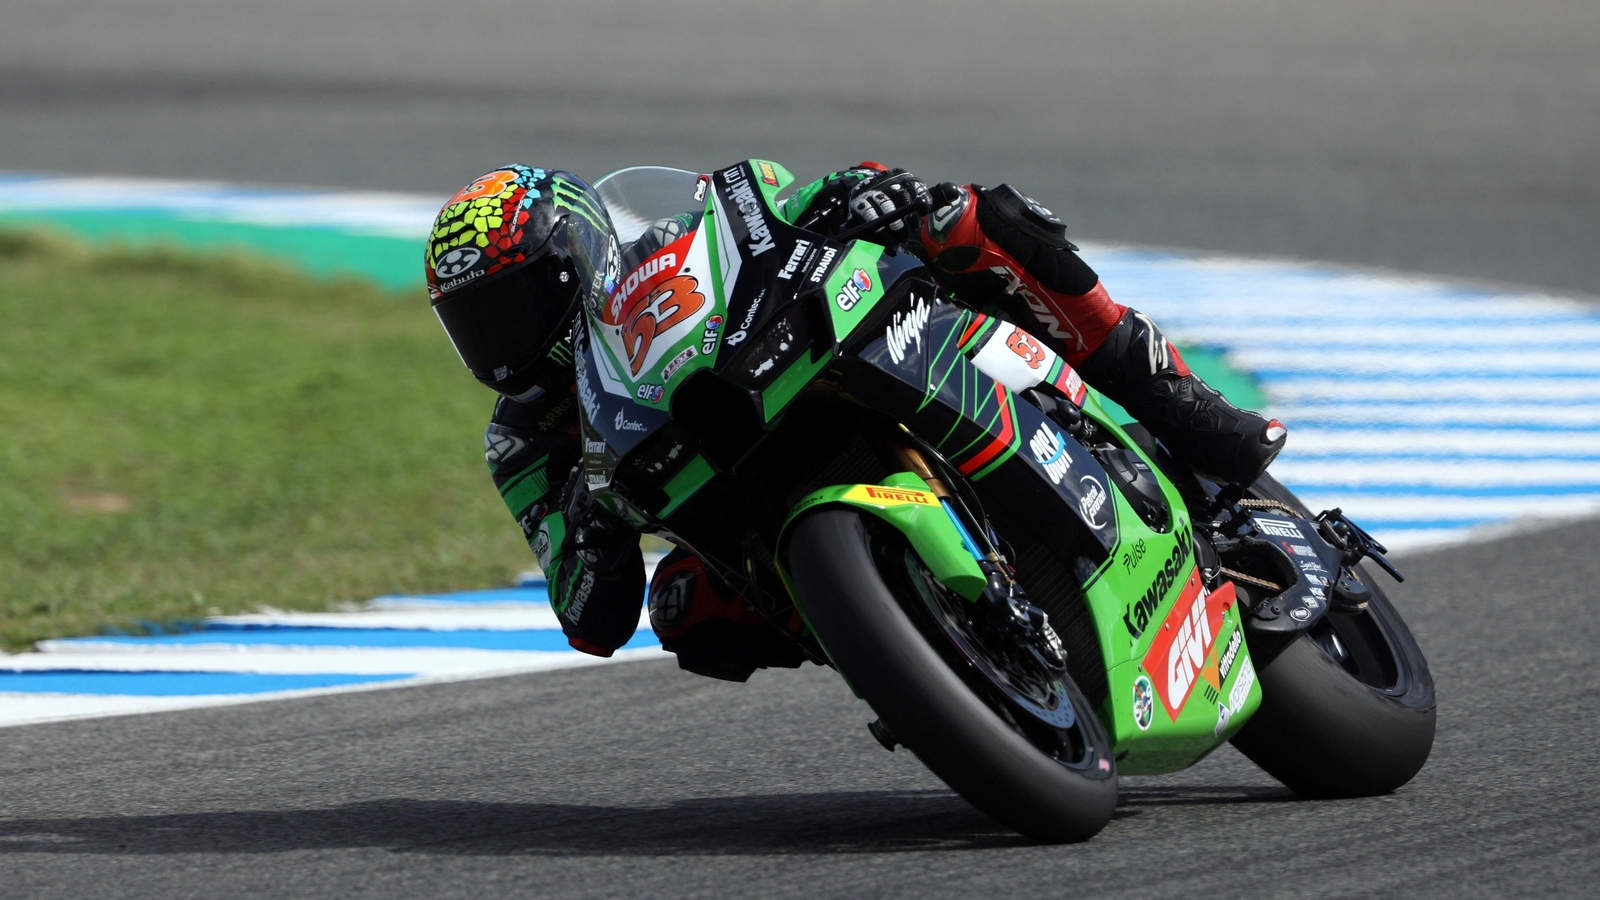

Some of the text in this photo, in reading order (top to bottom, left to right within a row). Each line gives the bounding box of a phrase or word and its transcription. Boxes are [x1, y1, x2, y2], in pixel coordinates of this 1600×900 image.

[777, 239, 811, 280] Ferrari
[440, 269, 485, 293] Kabuto
[611, 252, 677, 325] SHOWA
[621, 275, 705, 377] 53
[740, 296, 761, 330] Contec
[886, 292, 931, 365] Ninja
[1004, 326, 1046, 370] 53
[585, 437, 606, 453] Ferrari
[622, 419, 643, 431] Contec
[865, 486, 929, 504] PIRELLI
[1253, 517, 1305, 539] PIRELLI
[1122, 538, 1147, 576] Pulse
[565, 567, 595, 626] Kawasa
[1122, 517, 1194, 648] Kawasaki
[1167, 585, 1212, 710] GIVI
